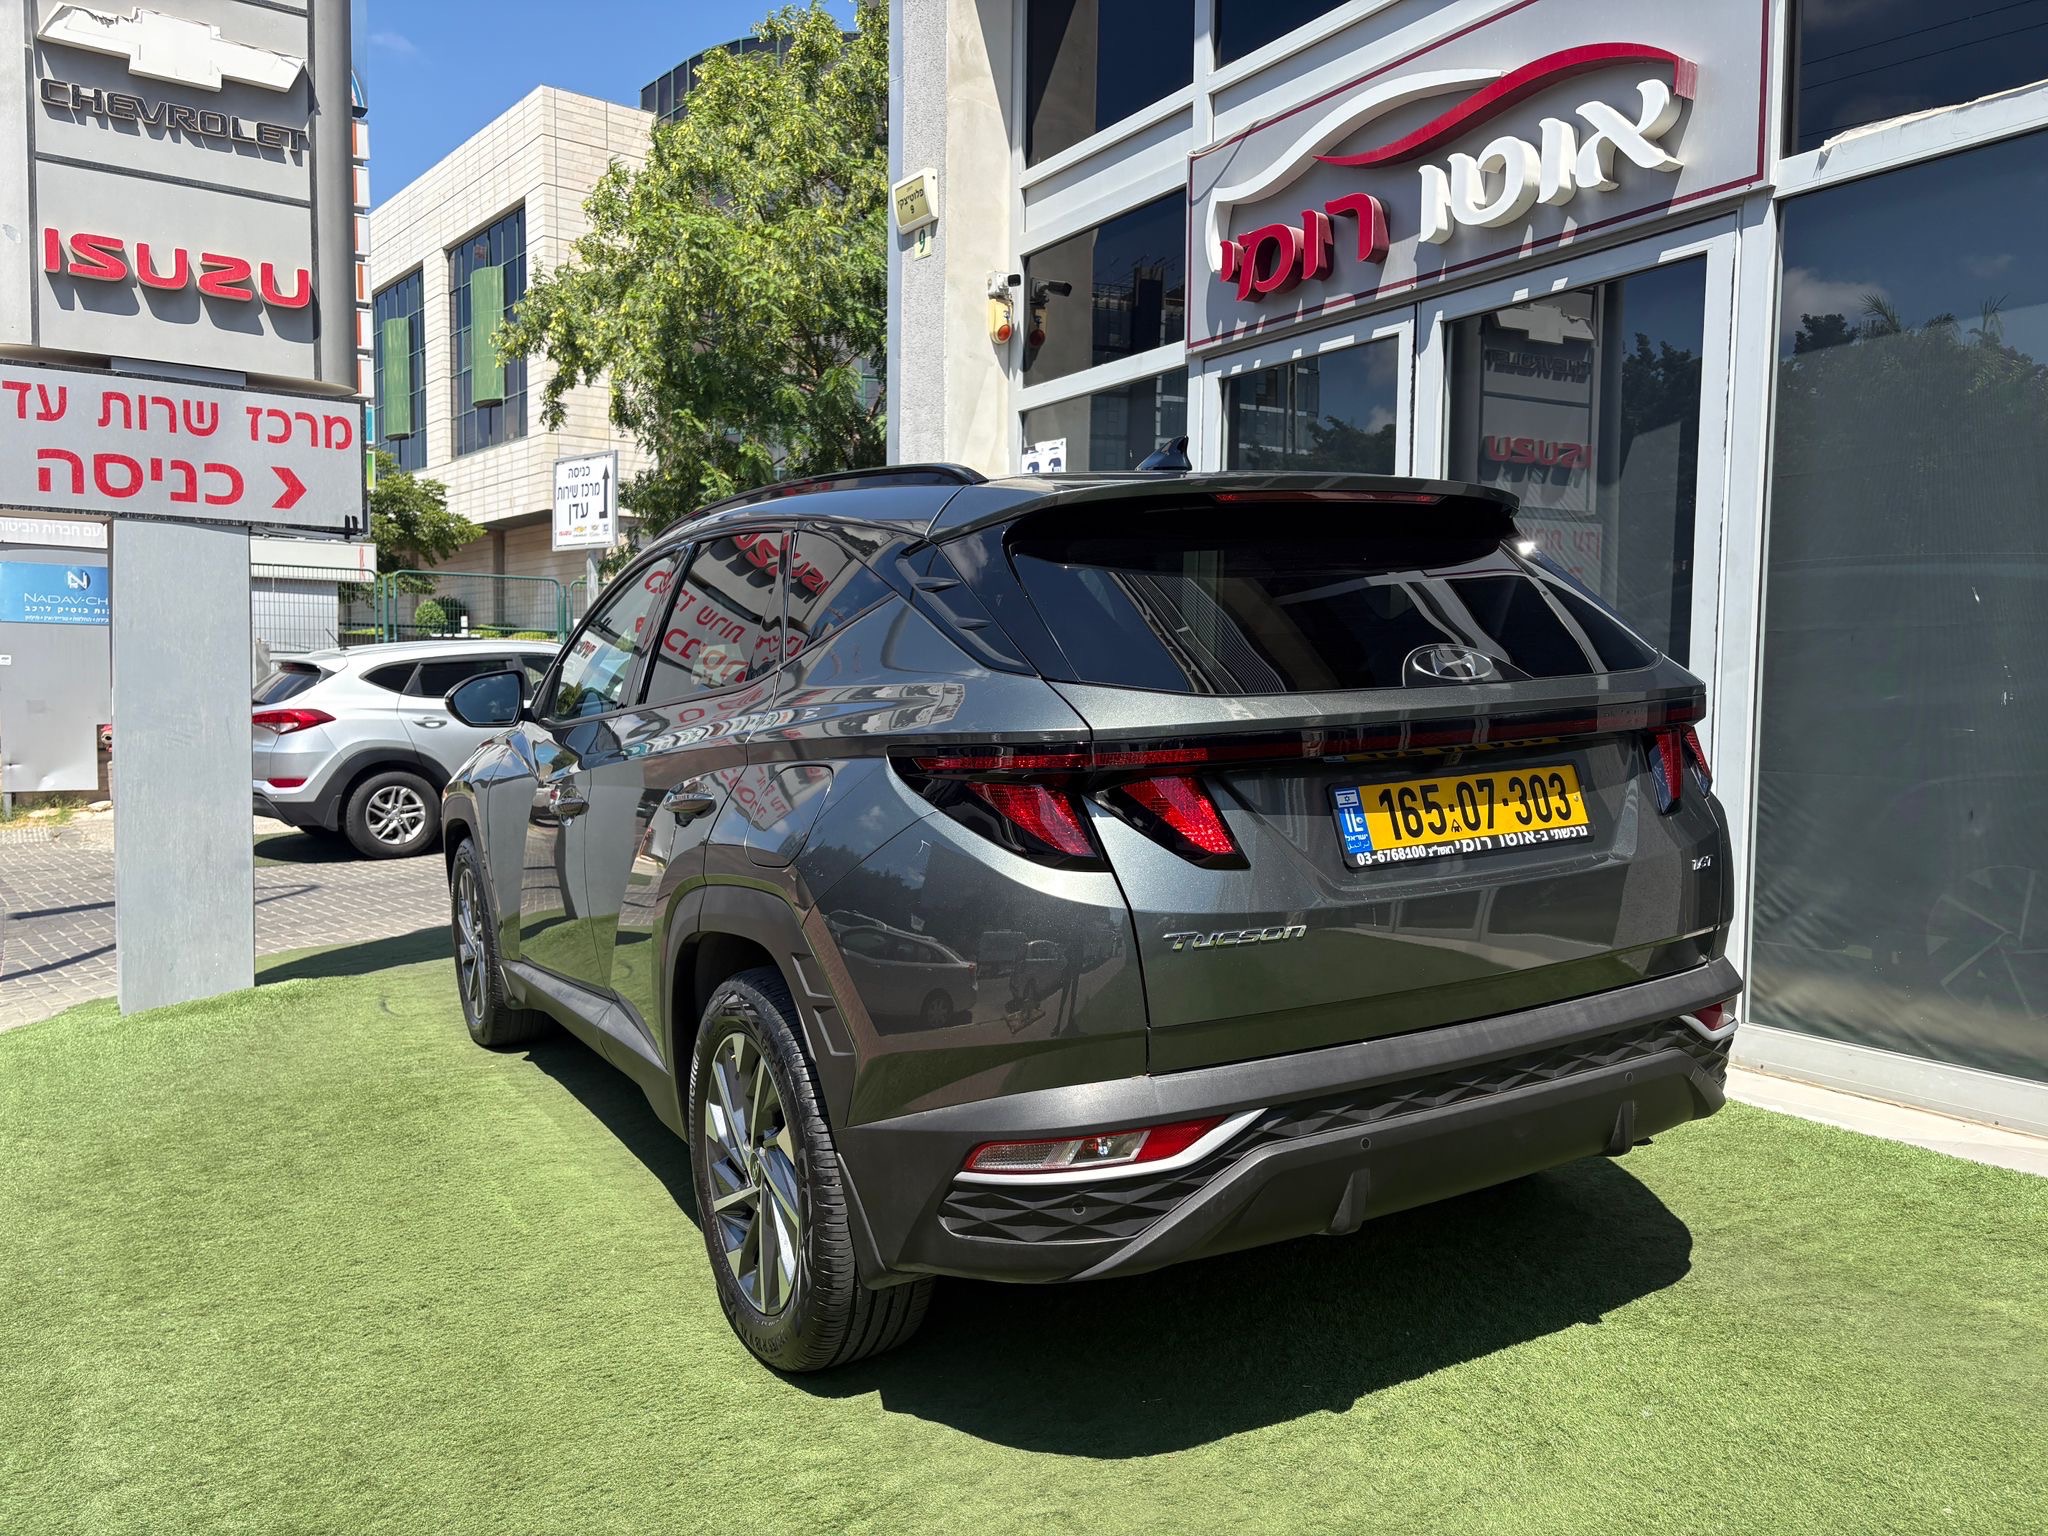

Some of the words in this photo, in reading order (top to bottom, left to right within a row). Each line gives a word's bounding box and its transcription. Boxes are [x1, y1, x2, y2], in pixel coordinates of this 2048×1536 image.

[40, 78, 306, 152] CHEVROLET
[1418, 79, 1683, 245] אוטו
[897, 188, 924, 210] פלוטיצקי
[909, 205, 915, 214] 9
[918, 228, 926, 254] 9
[1219, 193, 1390, 303] רומי
[44, 227, 311, 308] ISUZU
[97, 391, 219, 437] שרות
[246, 406, 353, 450] מרכז
[37, 448, 245, 505] כניסה
[567, 466, 591, 479] כניסה
[556, 484, 579, 500] שירות
[581, 482, 601, 497] מרכז
[568, 502, 589, 526] עדן
[1344, 833, 1368, 842] ישראל
[1499, 831, 1549, 848] ב-אוטו
[1550, 825, 1588, 840] נרכשתי
[1356, 845, 1427, 866] 03-6768100
[1455, 836, 1492, 853] רומי
